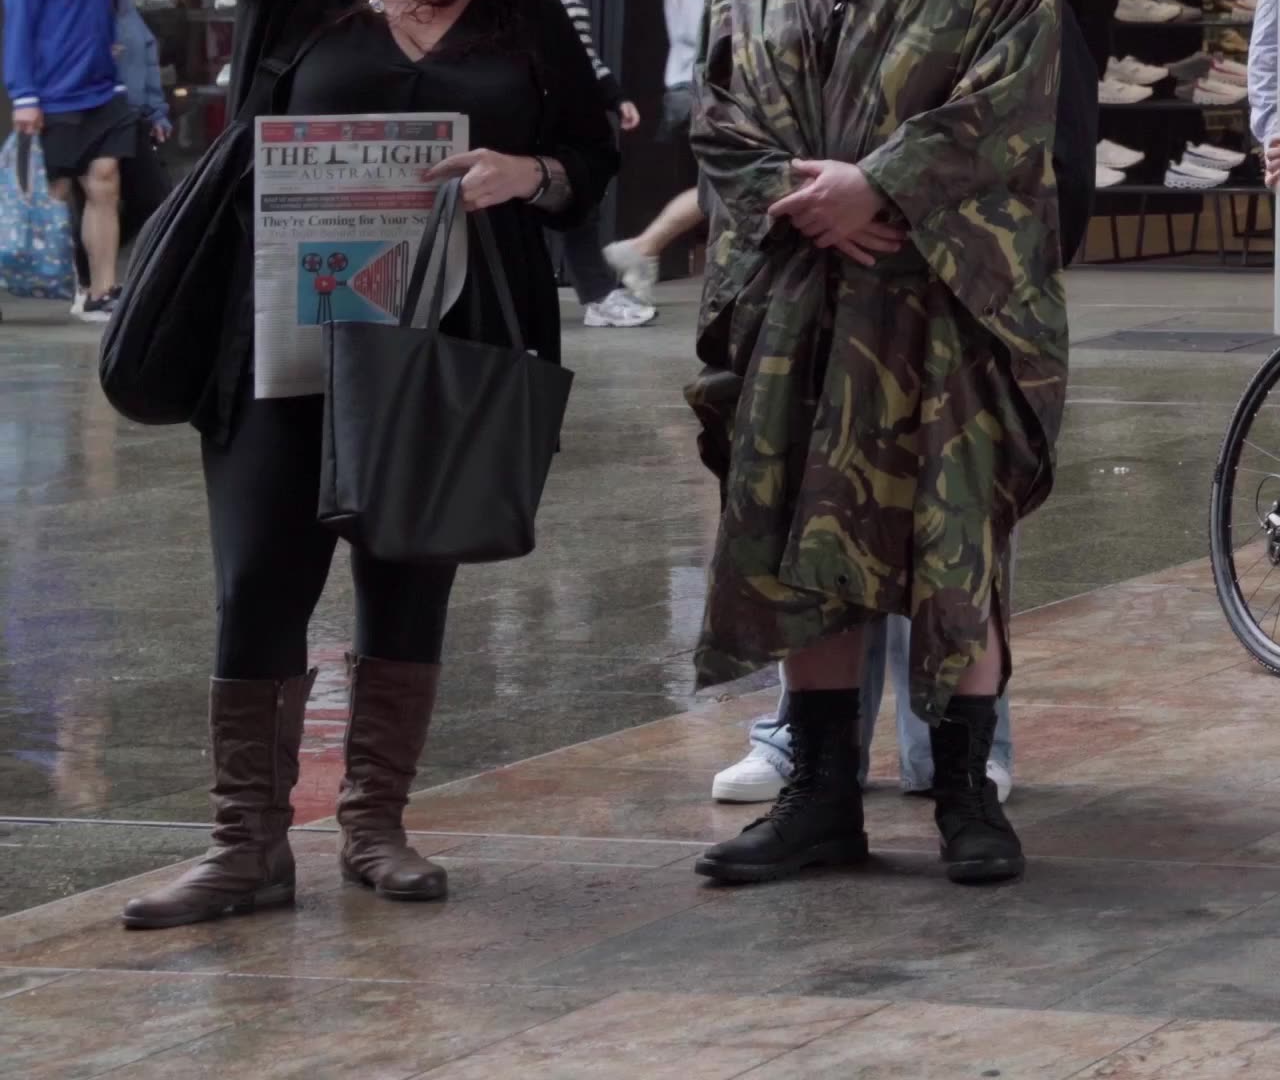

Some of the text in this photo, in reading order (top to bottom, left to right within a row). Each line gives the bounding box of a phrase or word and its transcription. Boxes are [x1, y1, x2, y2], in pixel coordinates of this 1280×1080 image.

[261, 145, 453, 166] THE LIGHT
[262, 215, 304, 229] They're
[309, 215, 355, 227] Coming
[359, 214, 374, 225] for
[379, 214, 402, 225] Your
